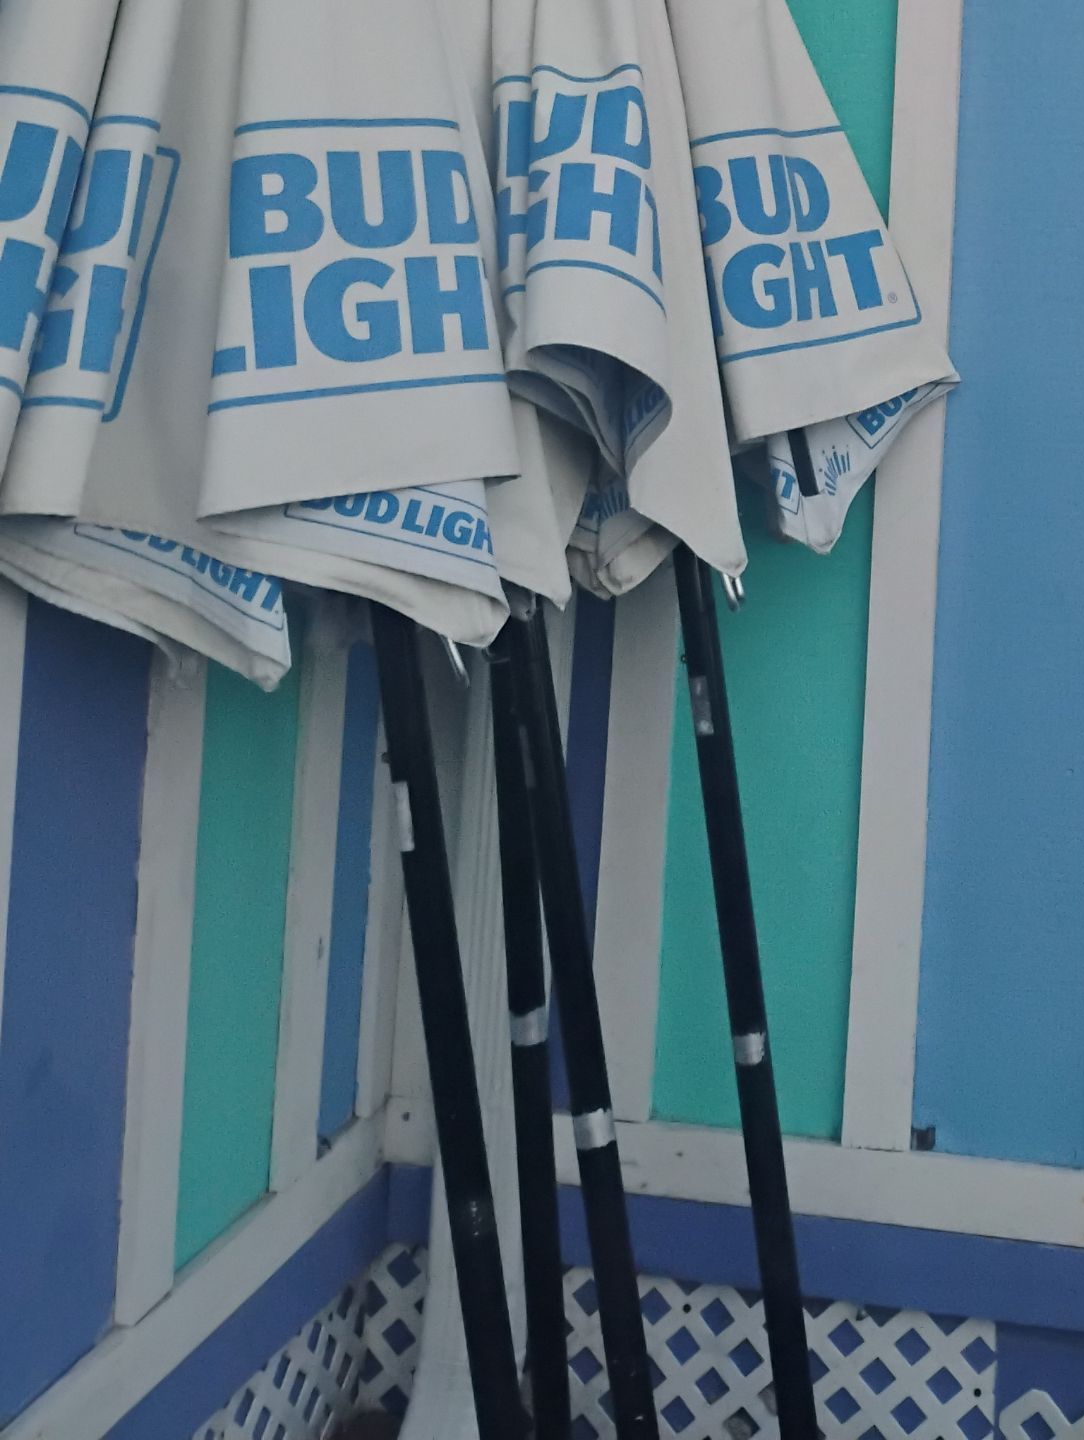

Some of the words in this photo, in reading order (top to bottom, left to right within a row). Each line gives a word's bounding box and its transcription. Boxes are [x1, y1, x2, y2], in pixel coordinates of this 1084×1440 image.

[529, 85, 652, 171] UD
[229, 149, 481, 259] BUD
[692, 153, 831, 248] BUD
[211, 255, 490, 379] IGH
[703, 228, 885, 337] GHT
[400, 499, 494, 556] LIGH
